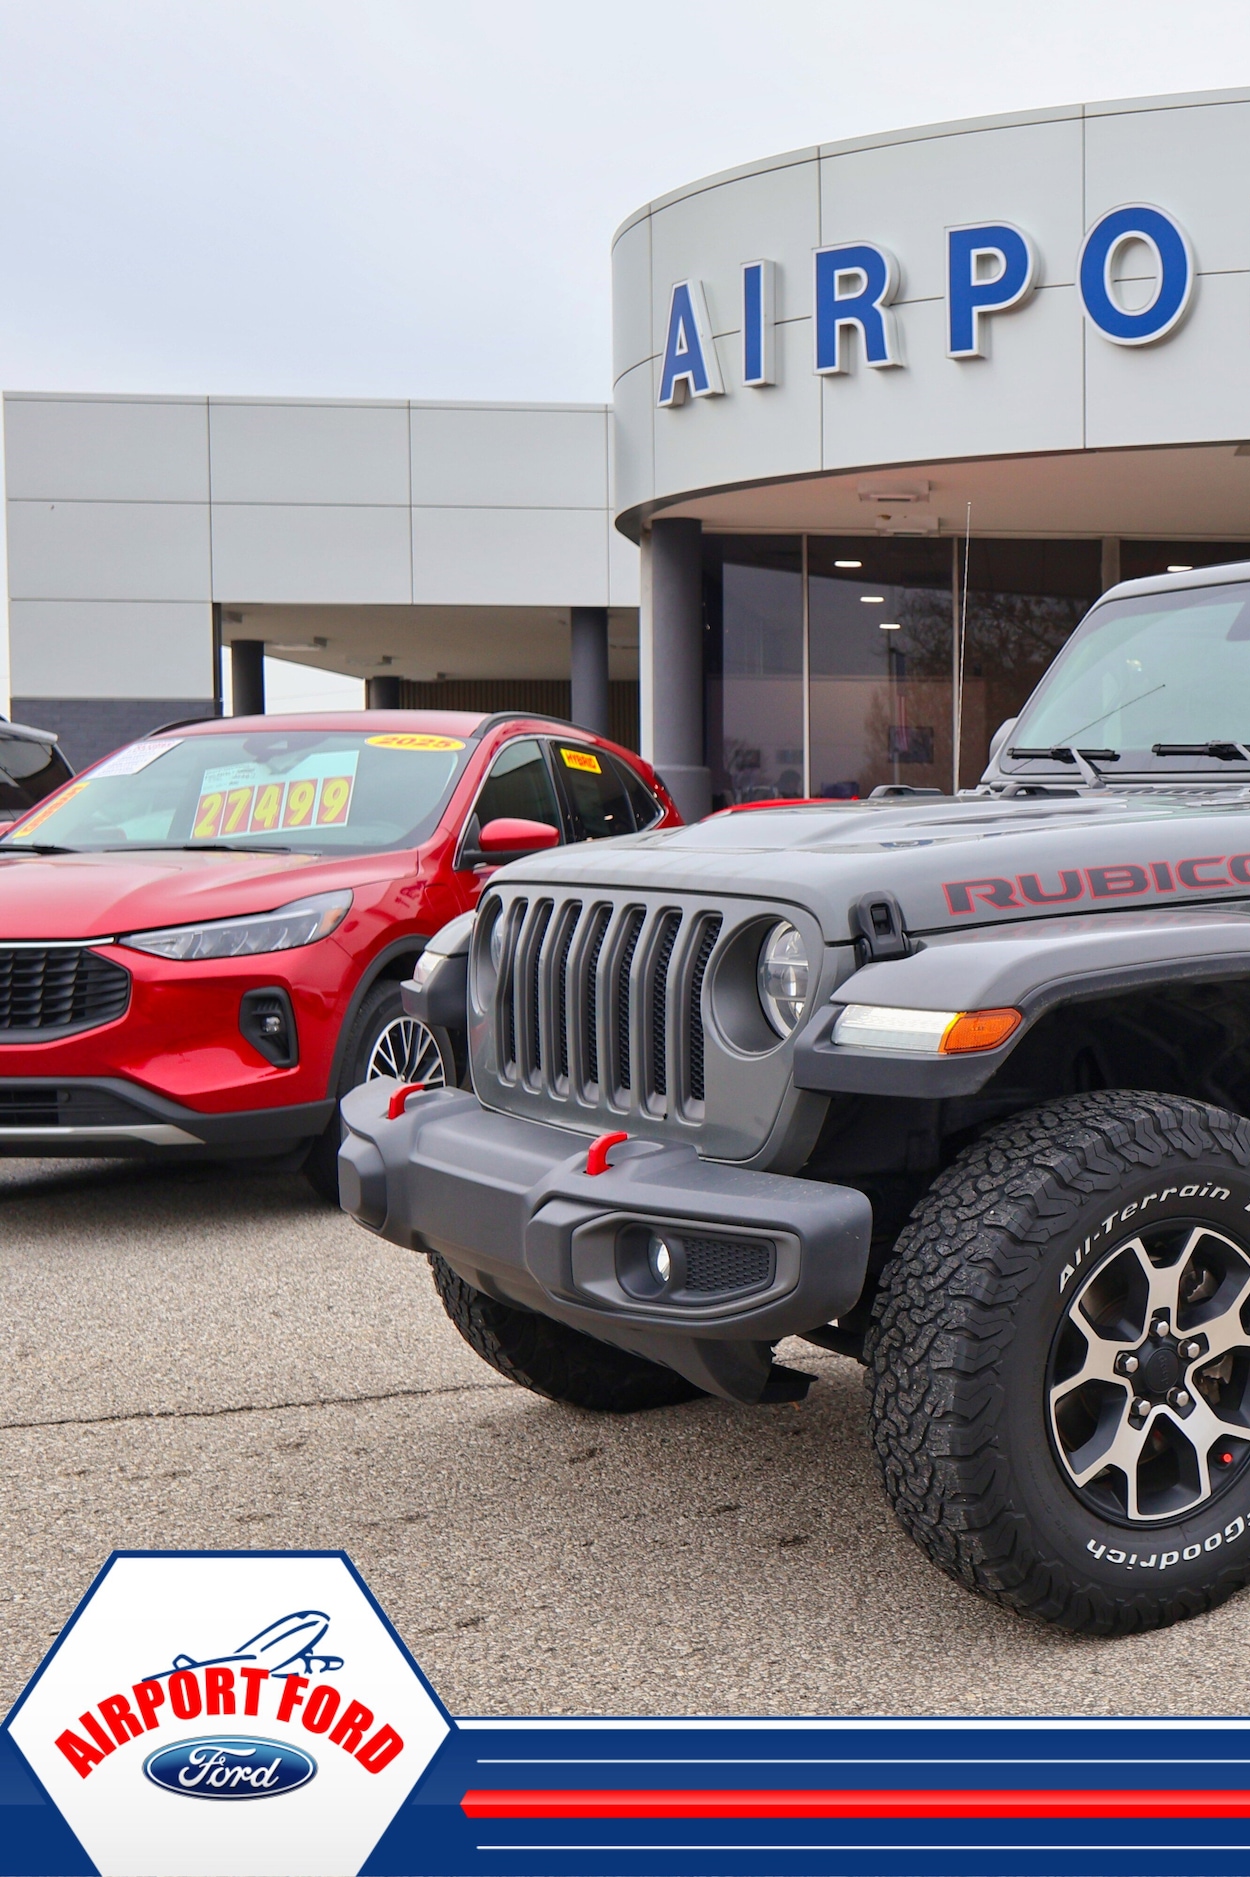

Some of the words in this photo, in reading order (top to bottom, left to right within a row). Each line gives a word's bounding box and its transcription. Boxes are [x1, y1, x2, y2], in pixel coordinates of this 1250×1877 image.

[379, 734, 453, 749] 2025
[192, 777, 350, 839] 27499
[1059, 1181, 1231, 1294] All-Terrain
